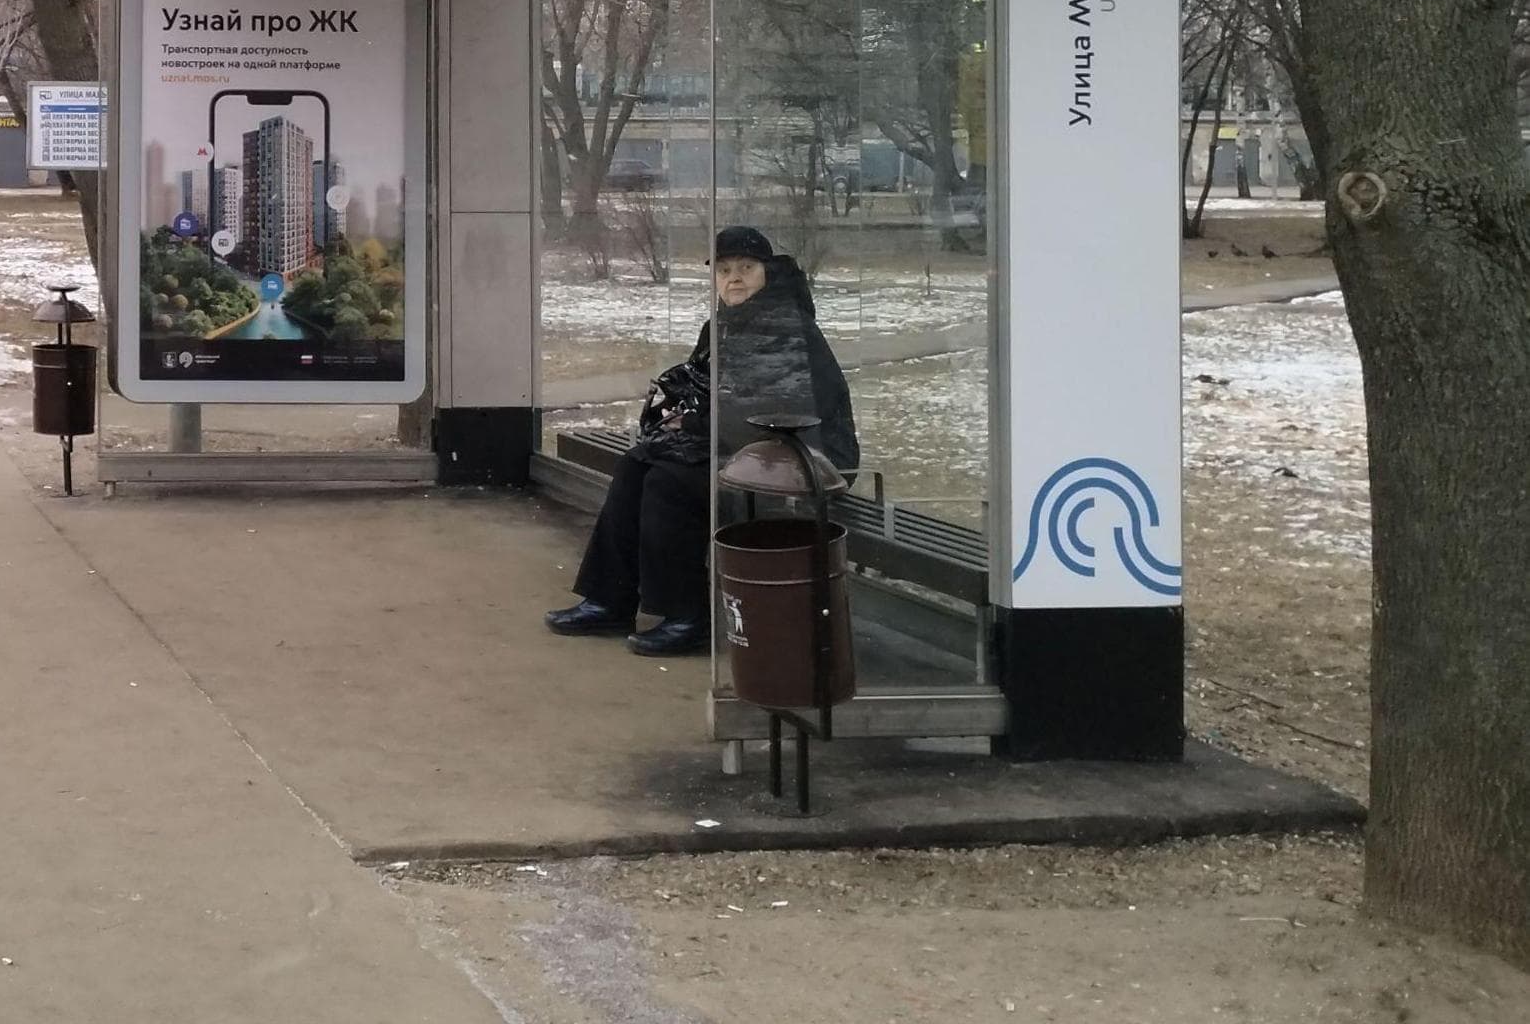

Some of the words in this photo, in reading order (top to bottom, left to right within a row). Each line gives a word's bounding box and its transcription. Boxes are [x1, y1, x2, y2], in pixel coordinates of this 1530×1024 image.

[161, 7, 241, 31] Узнай
[251, 14, 301, 37] про
[309, 9, 359, 33] ЖК
[161, 44, 238, 56] Транспортная
[240, 46, 308, 57] доступность
[161, 59, 225, 70] новостроек
[228, 60, 240, 69] на
[243, 59, 276, 70] одной
[279, 60, 341, 71] платформе
[1069, 36, 1094, 125] Улица
[59, 90, 83, 98] УЛИЦА
